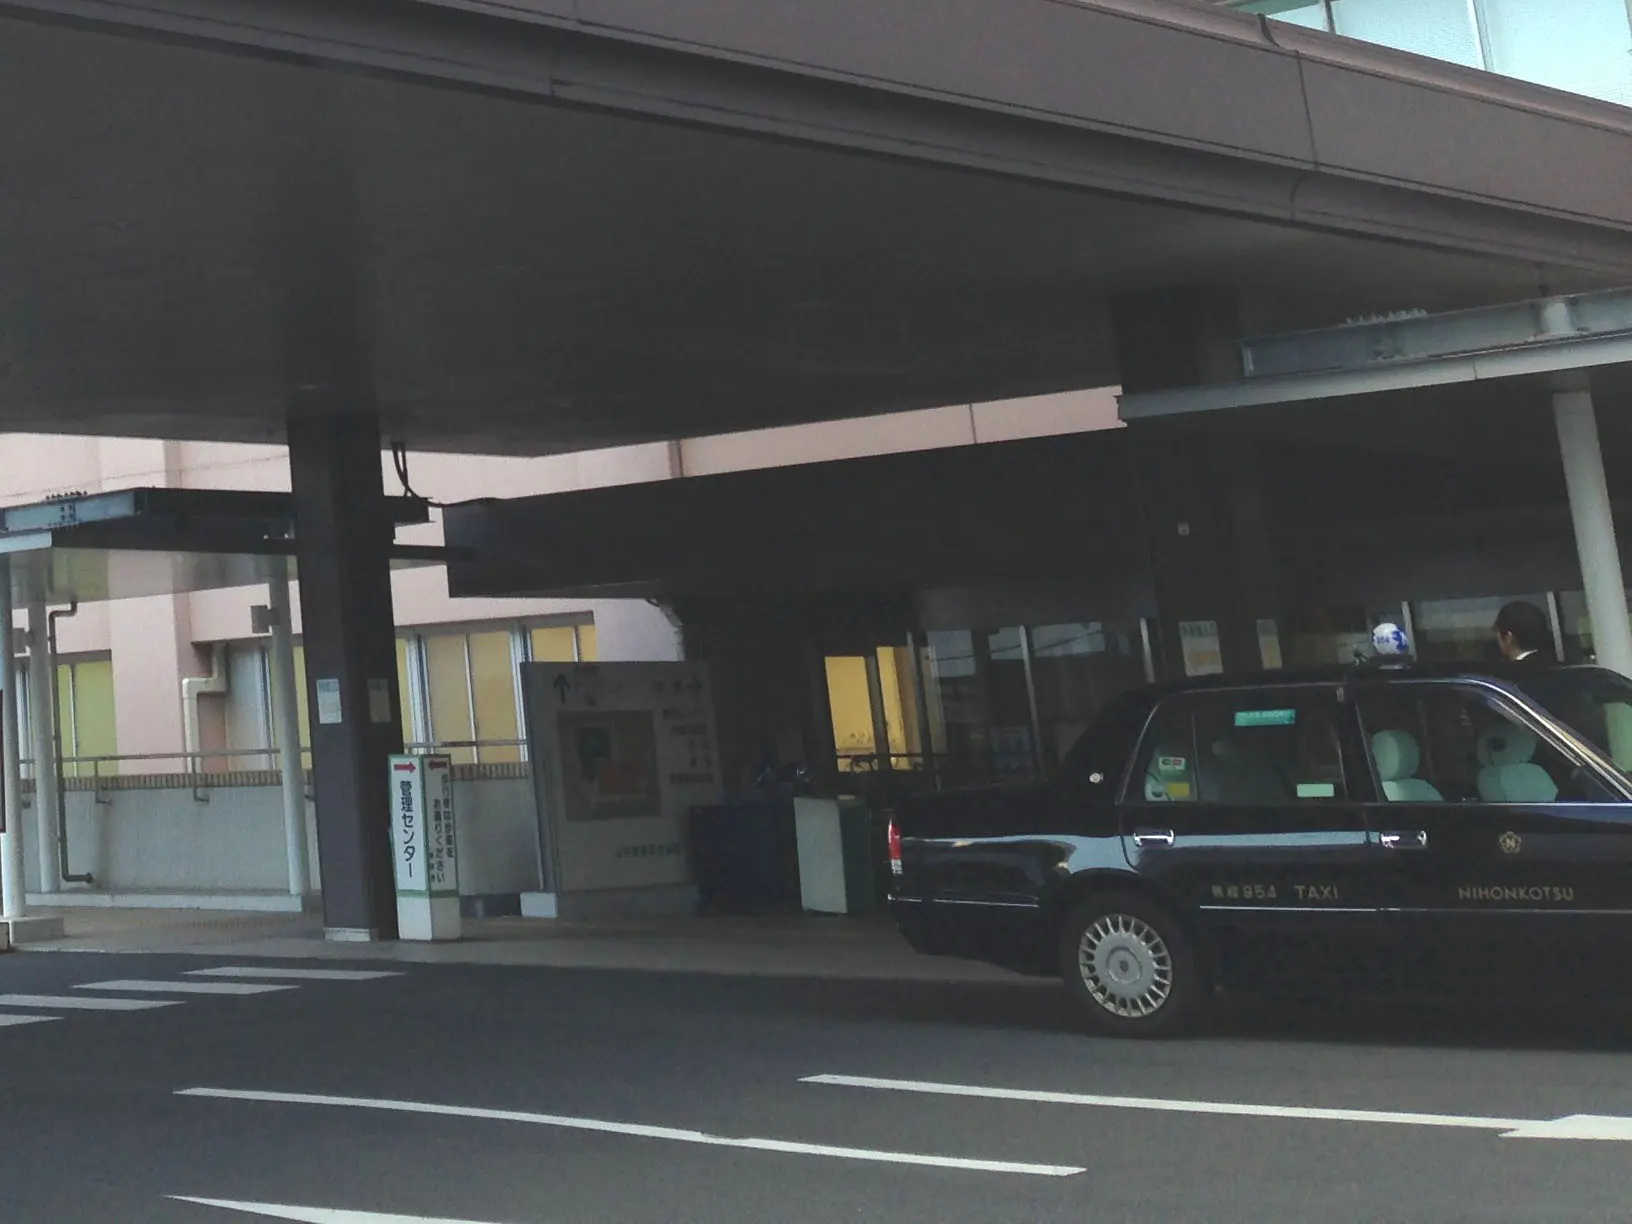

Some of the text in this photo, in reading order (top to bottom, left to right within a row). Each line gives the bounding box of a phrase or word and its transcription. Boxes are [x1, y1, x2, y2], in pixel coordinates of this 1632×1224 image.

[400, 780, 416, 877] 管理センター
[1293, 885, 1339, 901] TAXI
[1458, 886, 1574, 902] NIHONKOTSU
